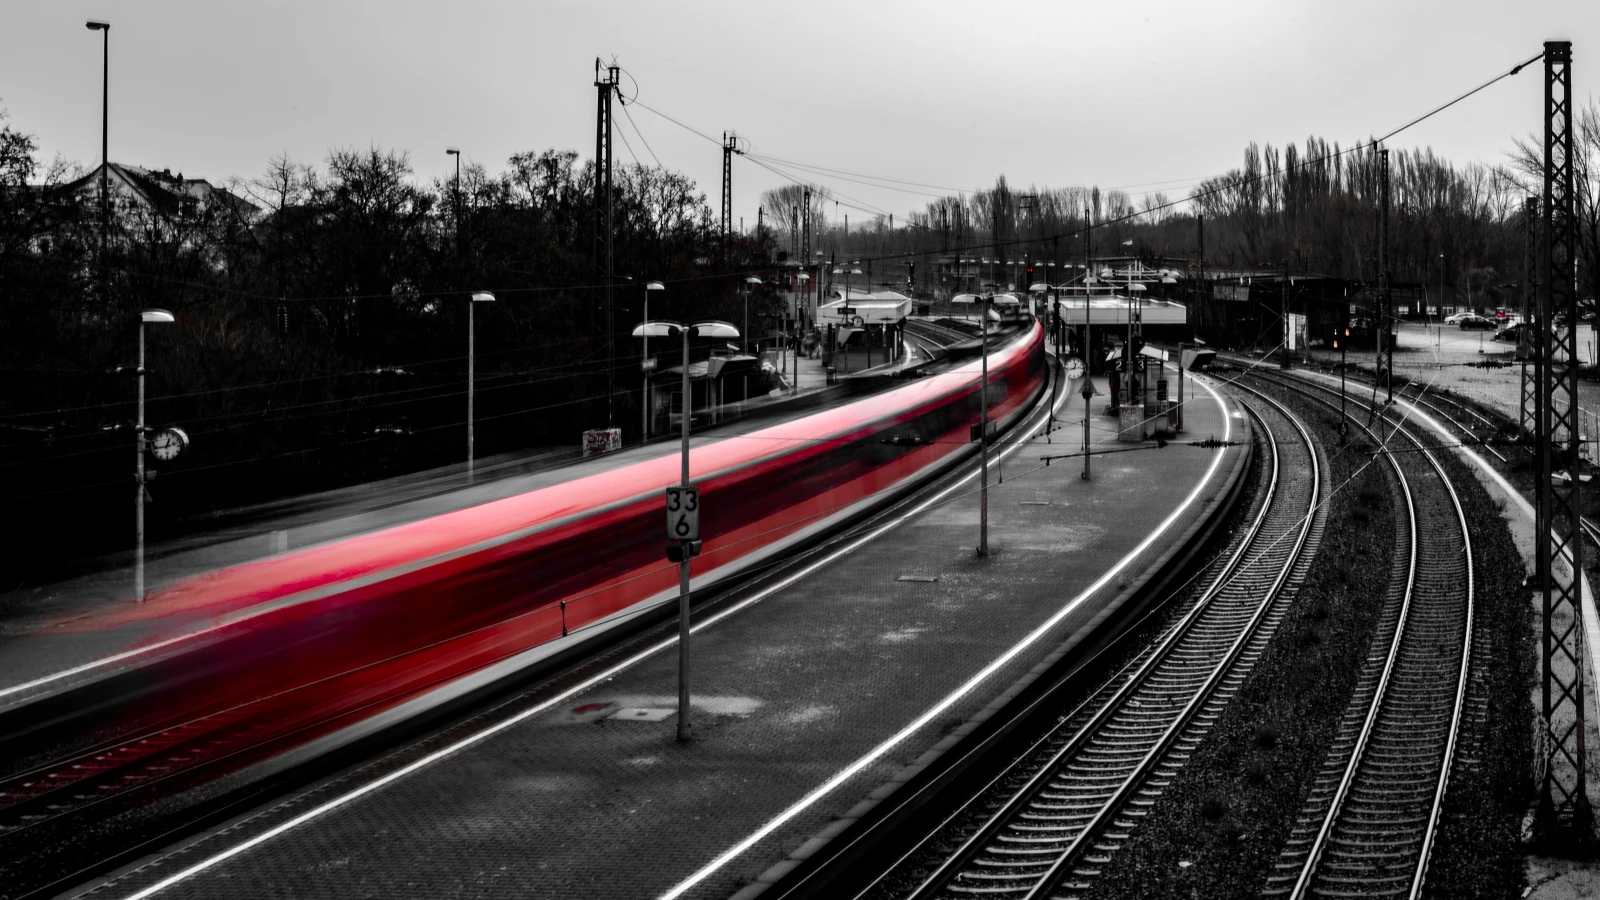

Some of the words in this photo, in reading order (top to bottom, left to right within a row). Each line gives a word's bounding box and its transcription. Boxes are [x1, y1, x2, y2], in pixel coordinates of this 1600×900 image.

[1115, 360, 1122, 371] 2
[1137, 360, 1145, 371] 3
[668, 490, 697, 512] 33
[675, 514, 690, 537] 6
